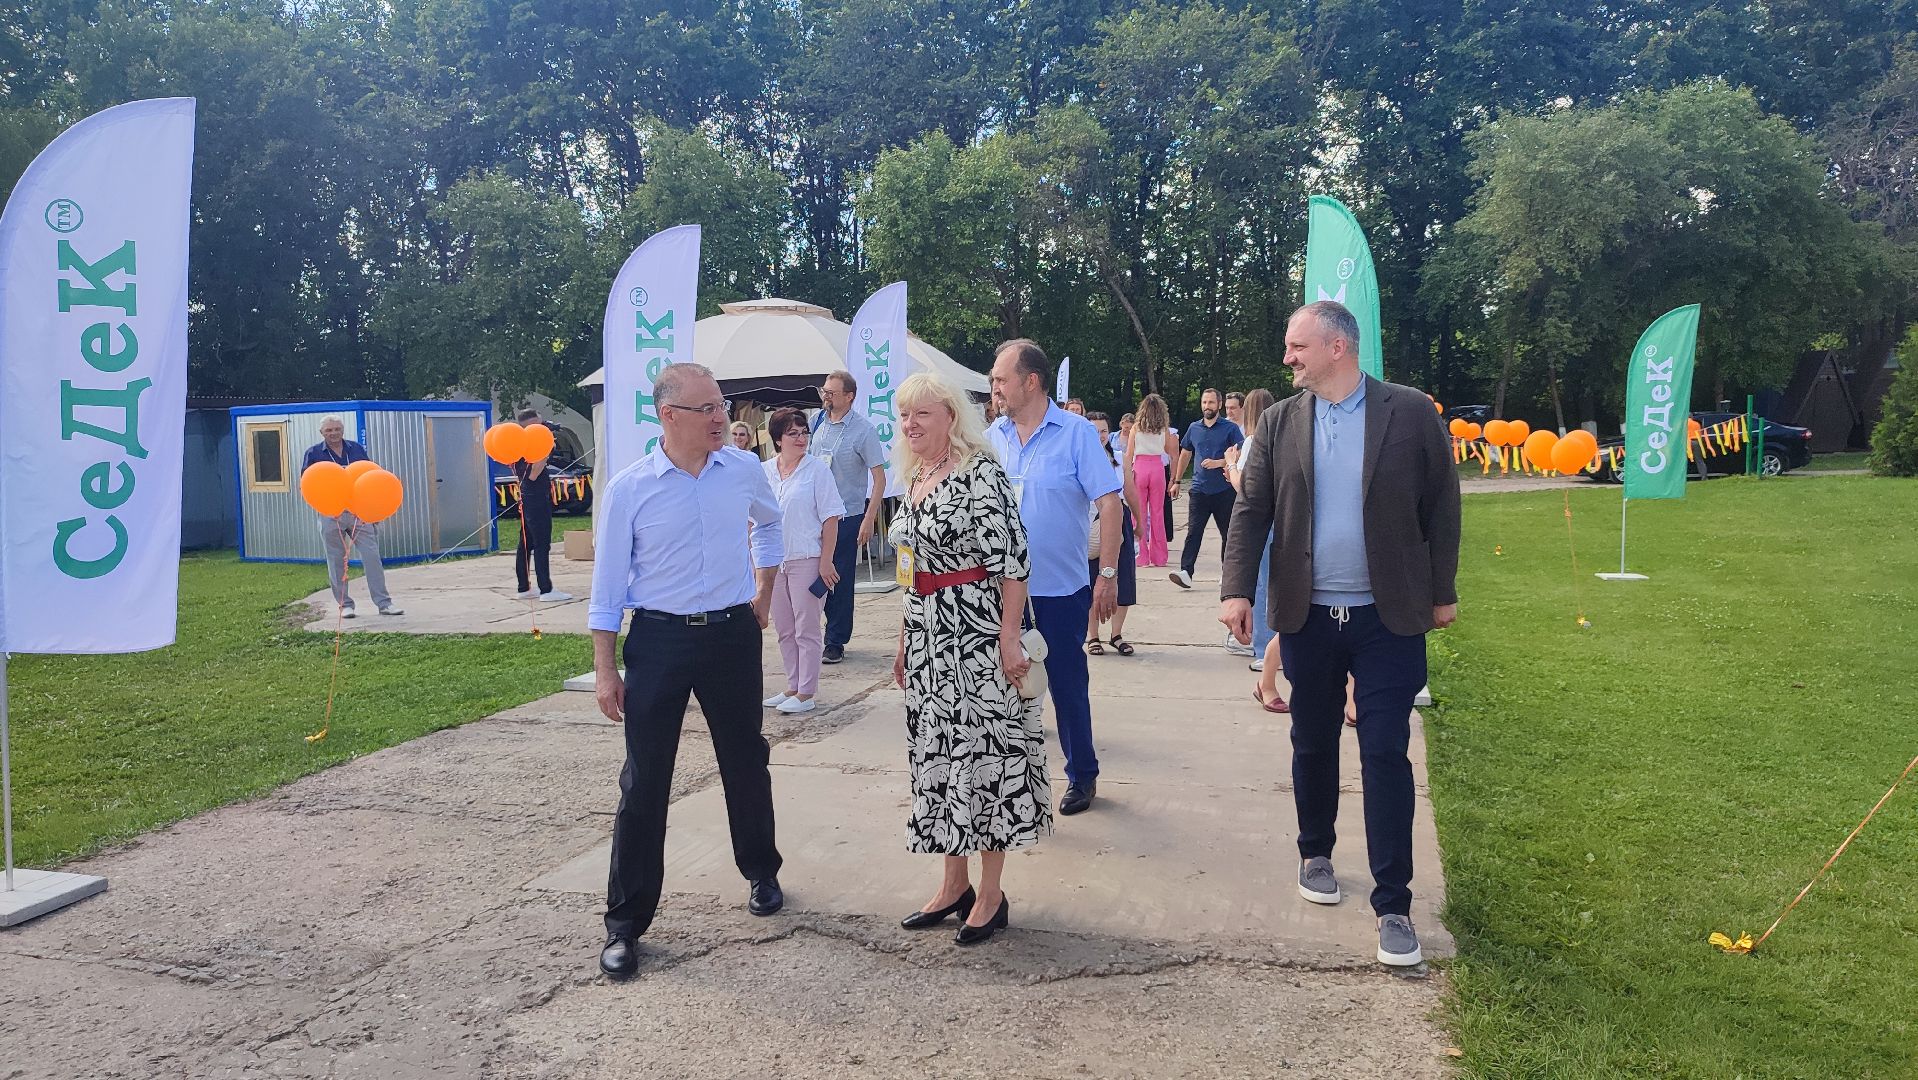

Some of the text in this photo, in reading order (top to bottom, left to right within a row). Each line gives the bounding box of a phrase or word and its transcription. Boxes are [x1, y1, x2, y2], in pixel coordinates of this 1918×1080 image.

[53, 240, 152, 579] СеДеК
[865, 340, 896, 470] еДеК
[1641, 356, 1674, 474] СеДеК
